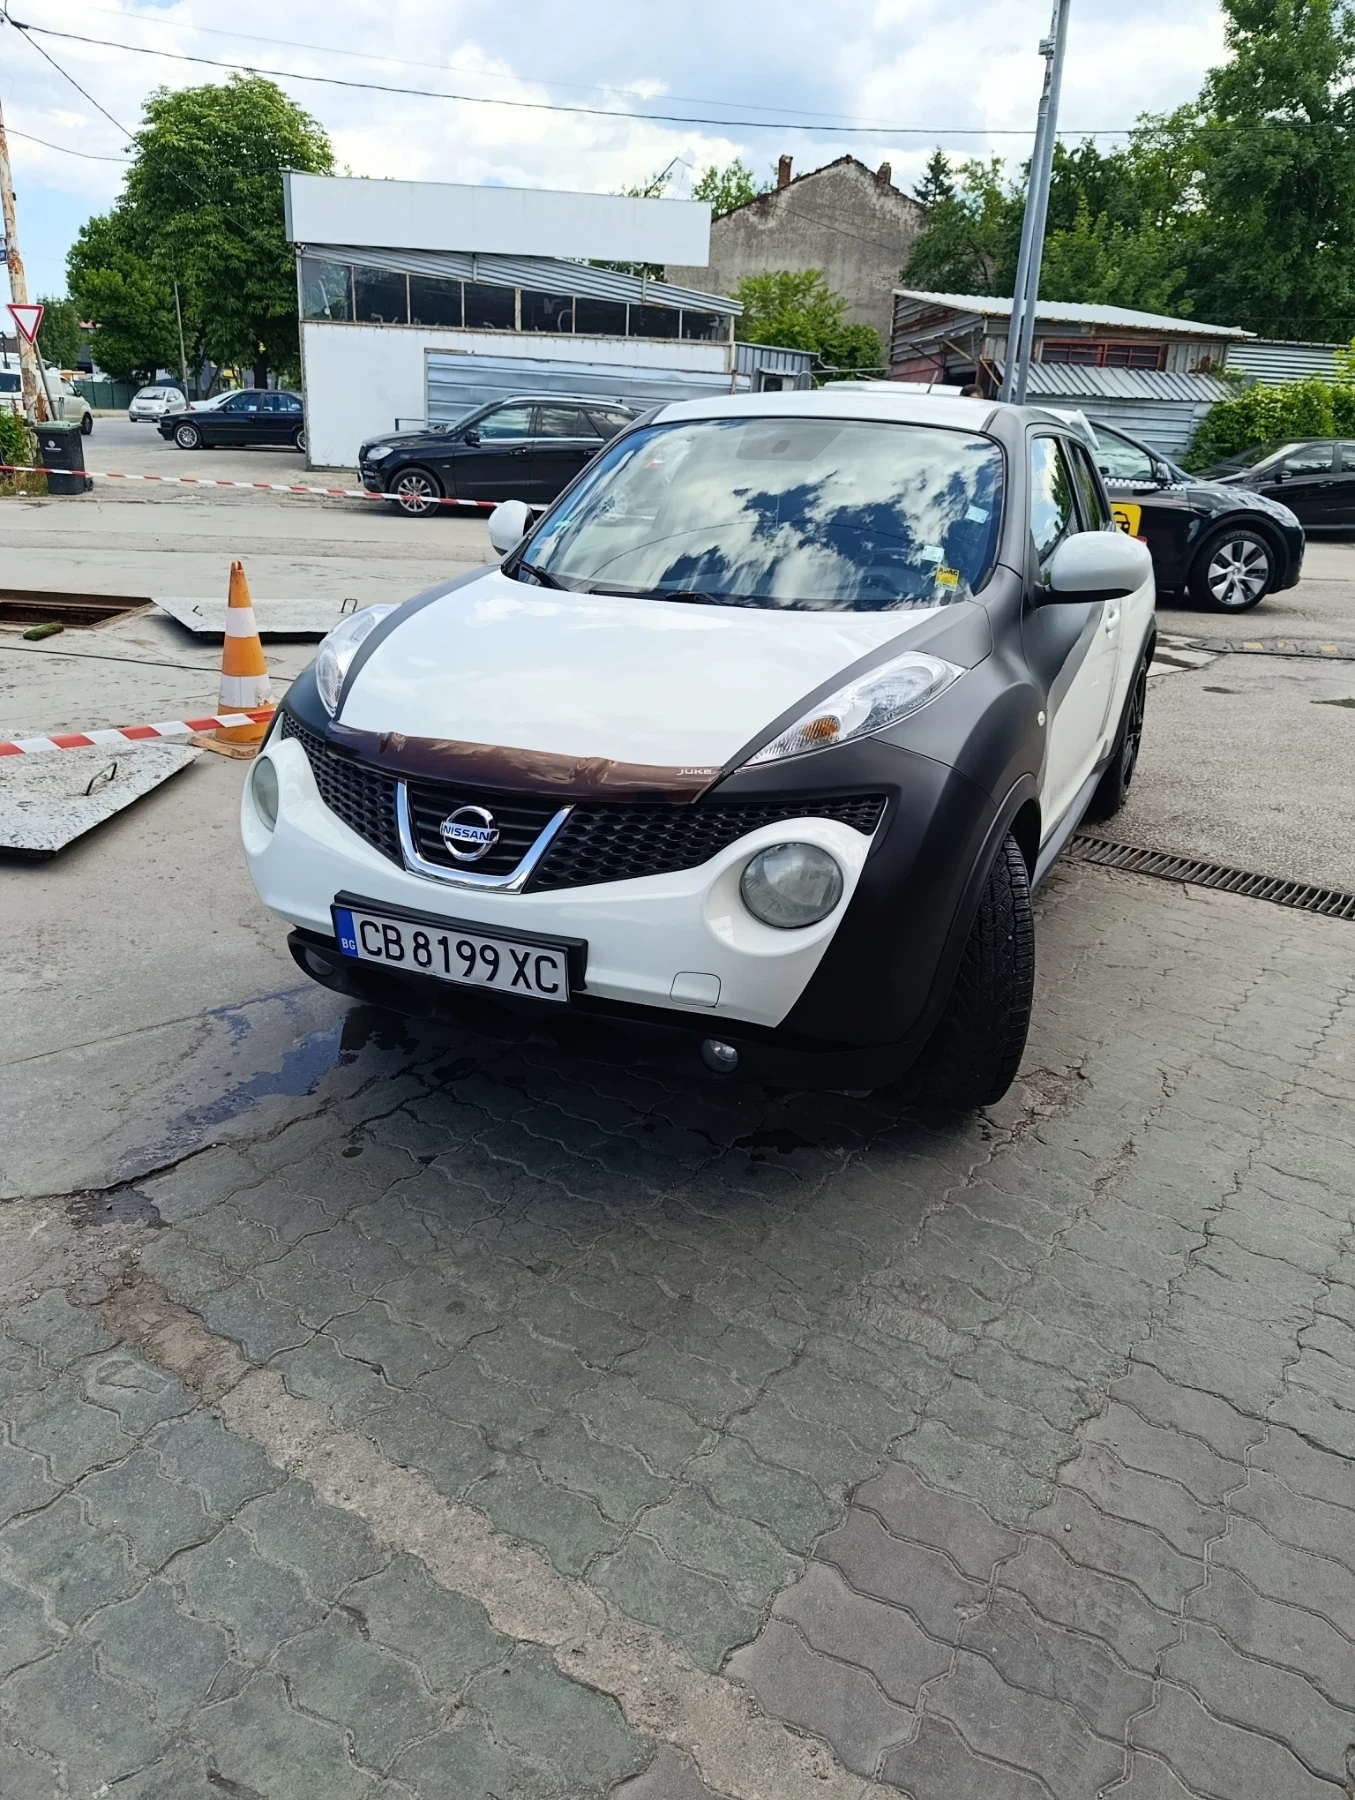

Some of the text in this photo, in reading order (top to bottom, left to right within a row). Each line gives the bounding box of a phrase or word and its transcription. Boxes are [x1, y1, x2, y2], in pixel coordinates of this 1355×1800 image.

[677, 768, 712, 776] JUKE
[443, 825, 490, 841] NISSAN
[341, 938, 356, 950] BG
[359, 920, 559, 994] CB 8199 XC
